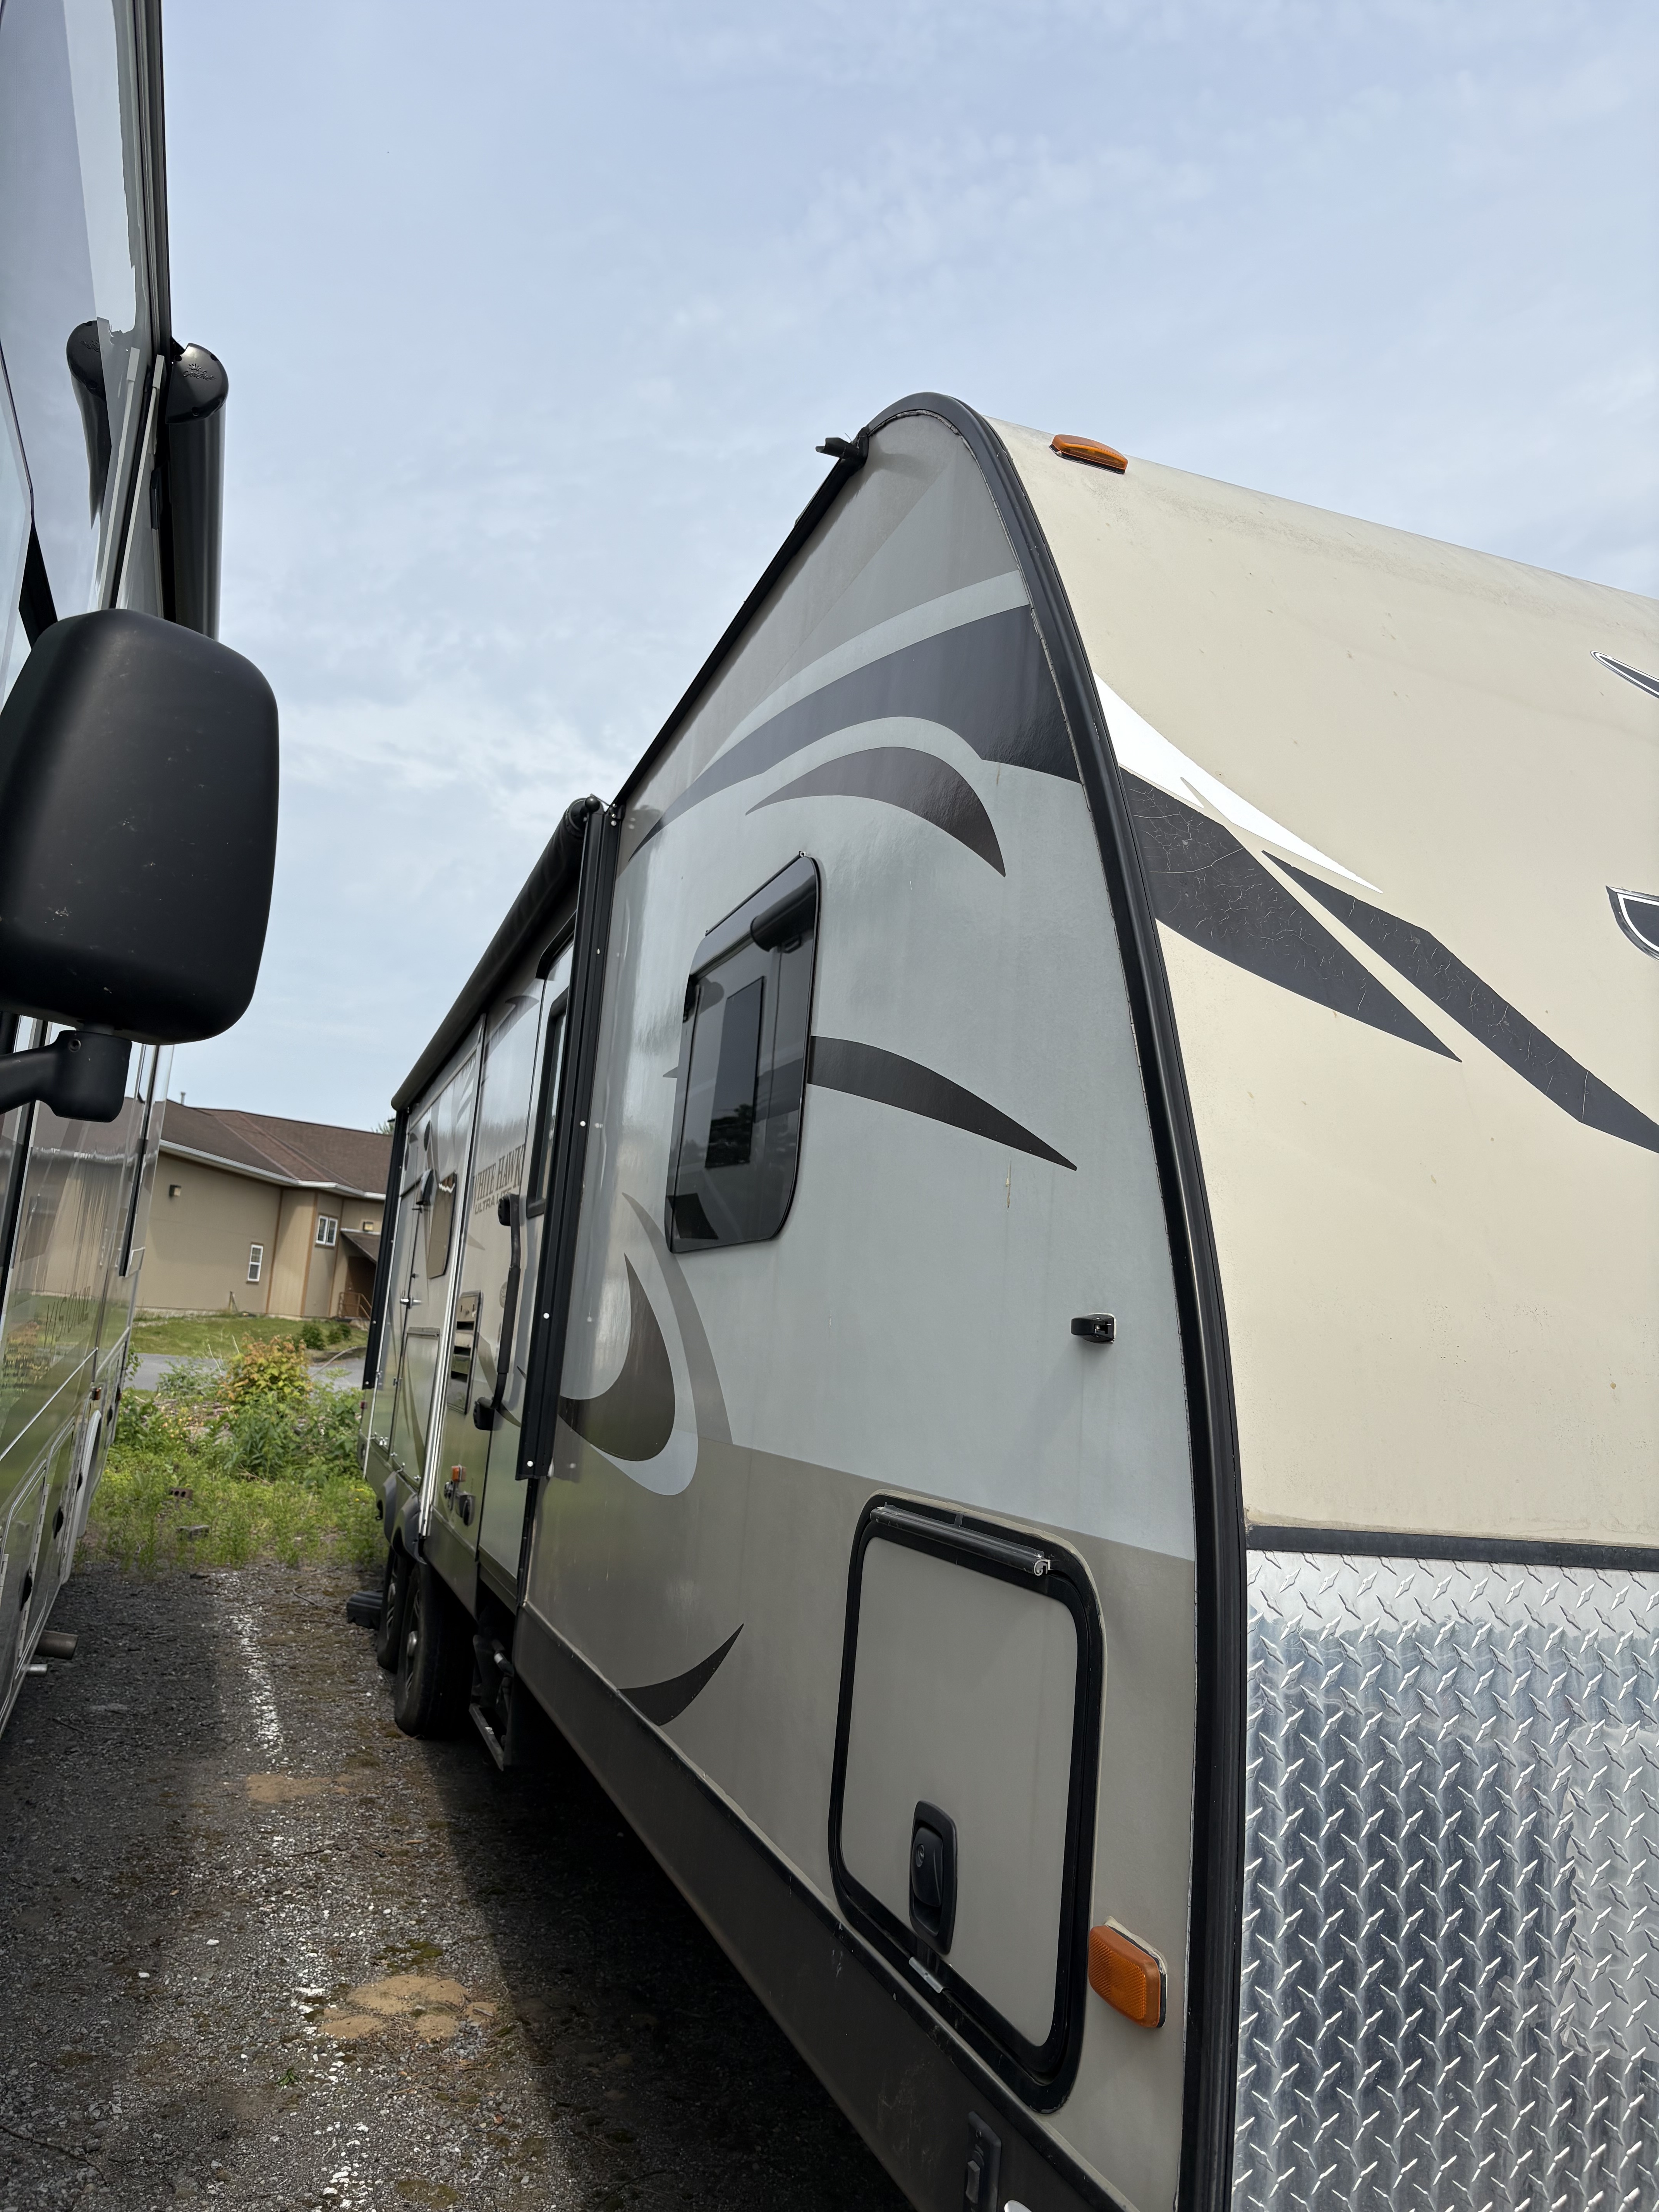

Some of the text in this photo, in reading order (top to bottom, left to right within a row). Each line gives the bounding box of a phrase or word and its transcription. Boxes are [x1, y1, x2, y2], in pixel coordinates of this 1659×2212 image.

[473, 1143, 525, 1209] WHITE HAWK
[474, 1195, 495, 1215] ULTRA
